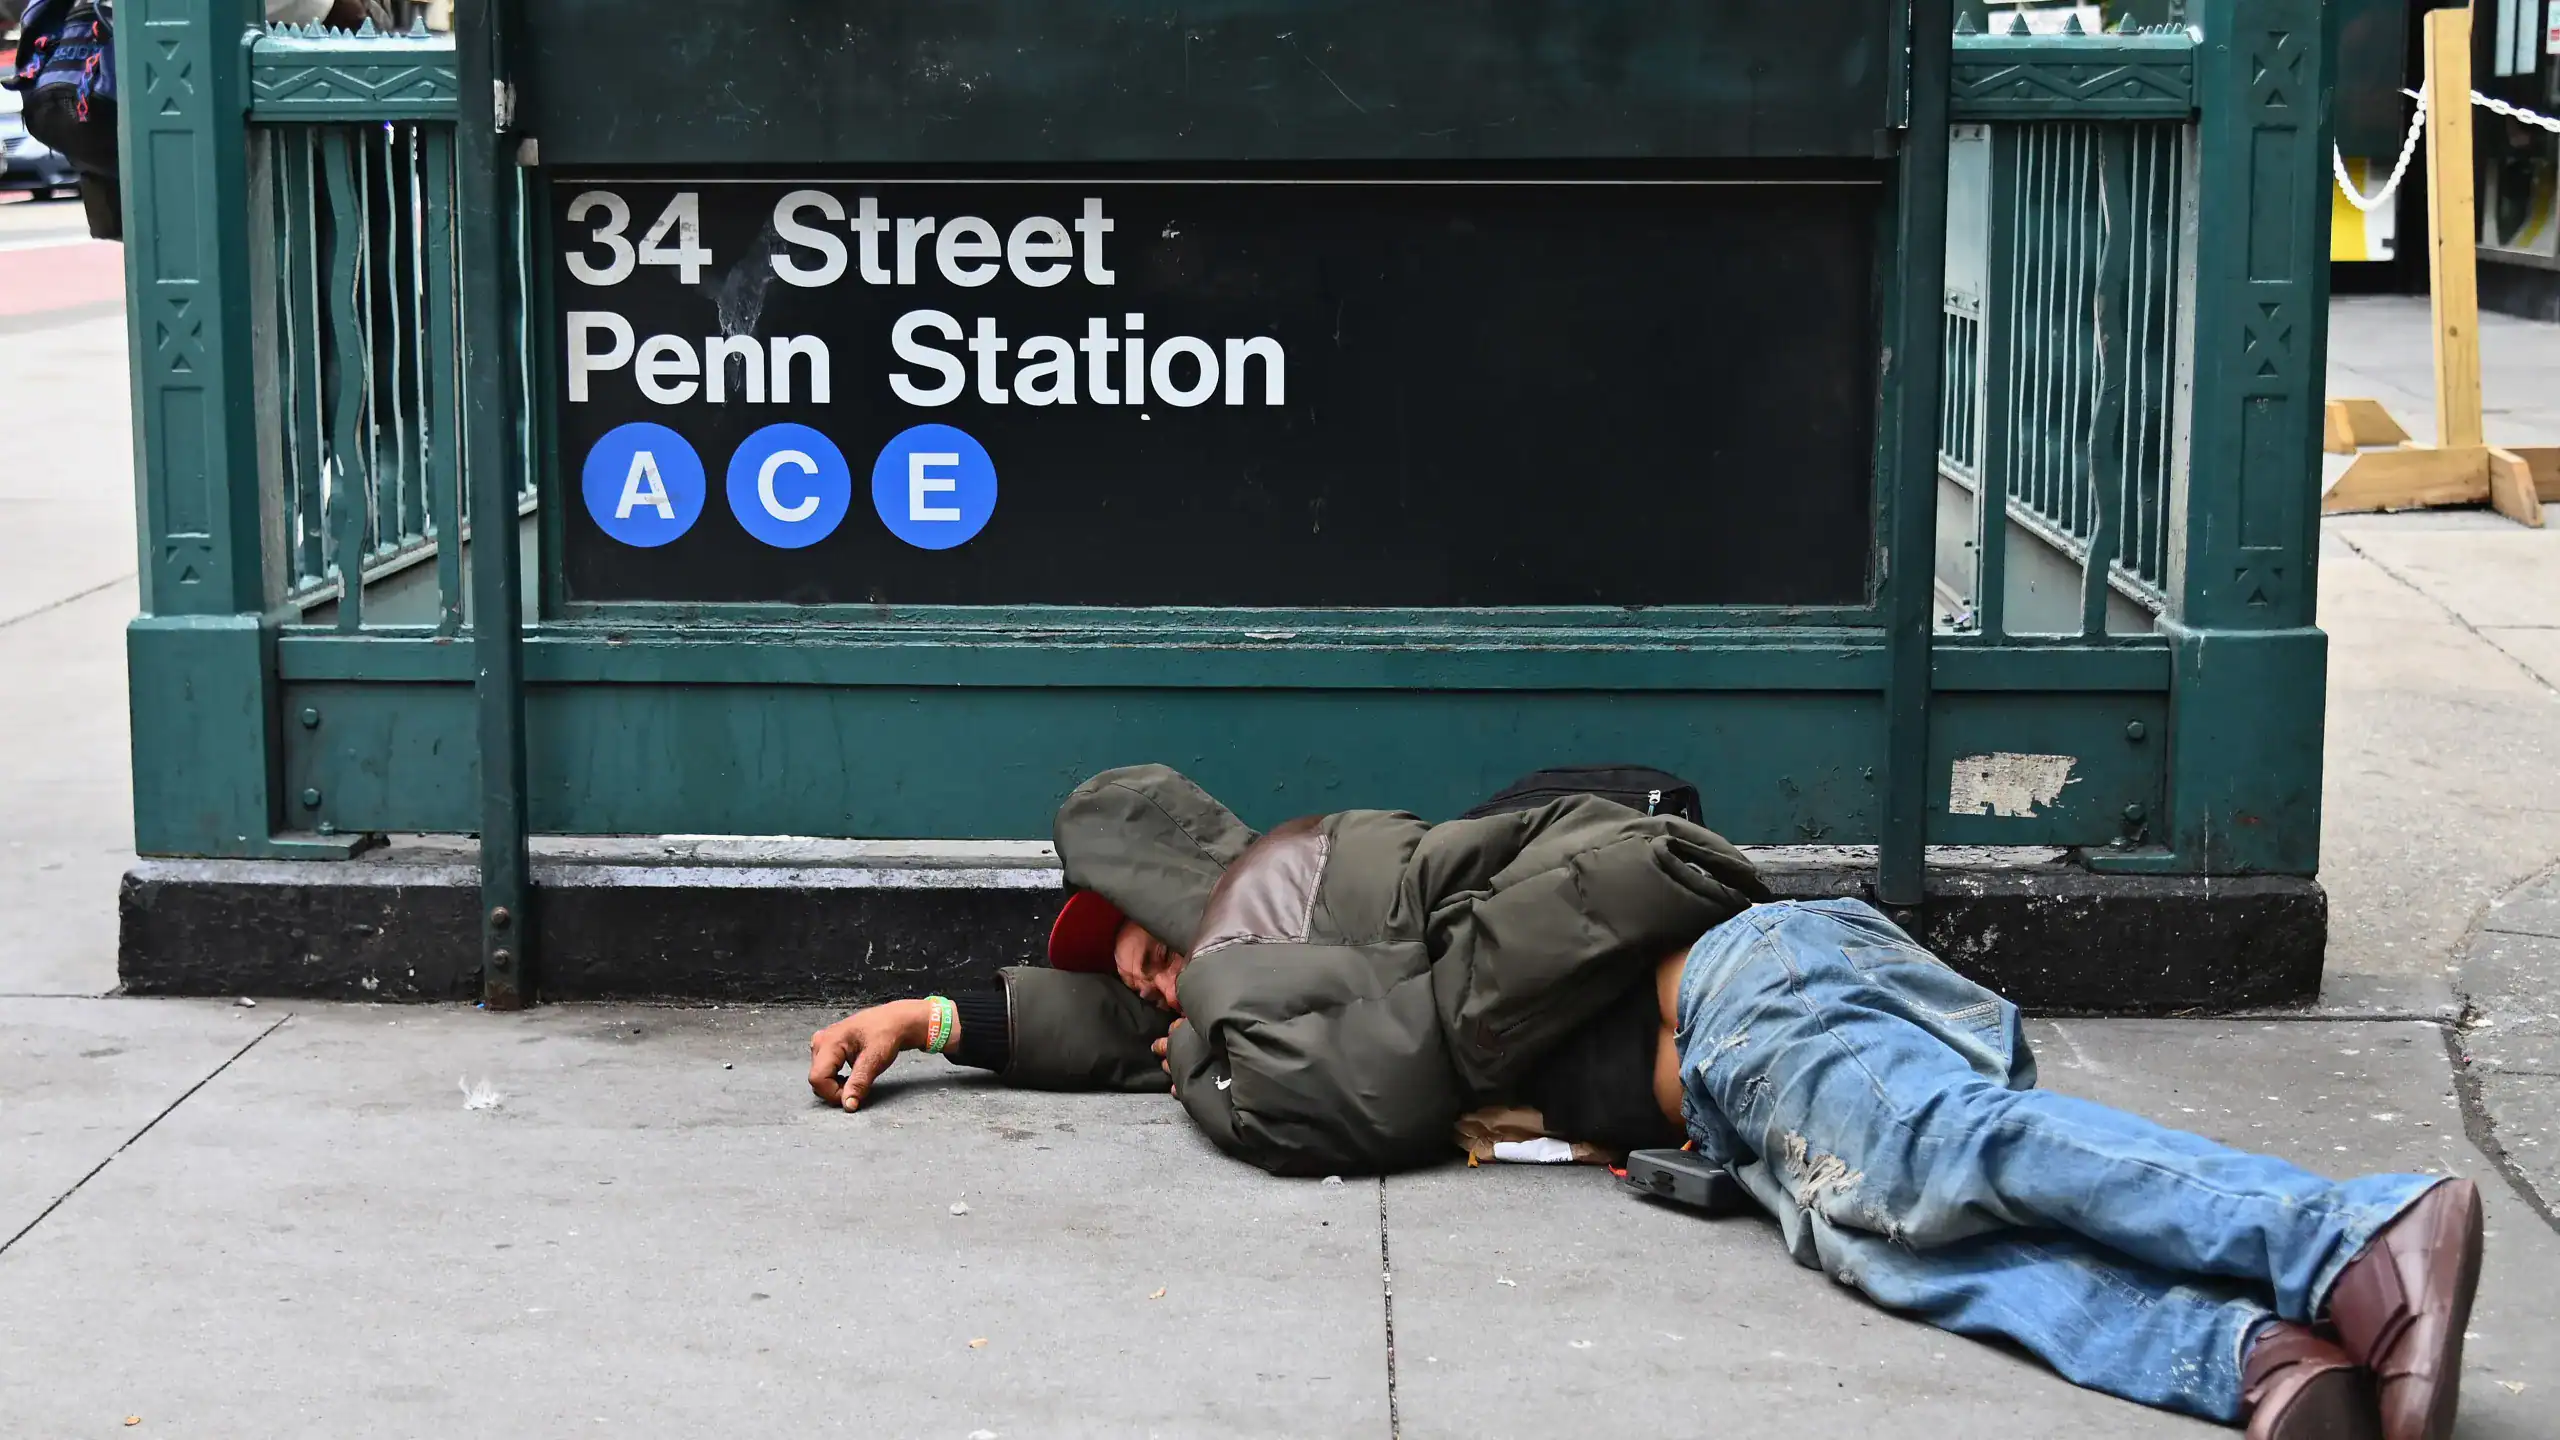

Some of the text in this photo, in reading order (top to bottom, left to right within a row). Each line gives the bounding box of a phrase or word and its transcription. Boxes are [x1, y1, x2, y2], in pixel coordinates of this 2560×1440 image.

[565, 190, 1116, 288] 34 Street
[566, 309, 1286, 408] Penn Station
[614, 449, 962, 522] A C E
